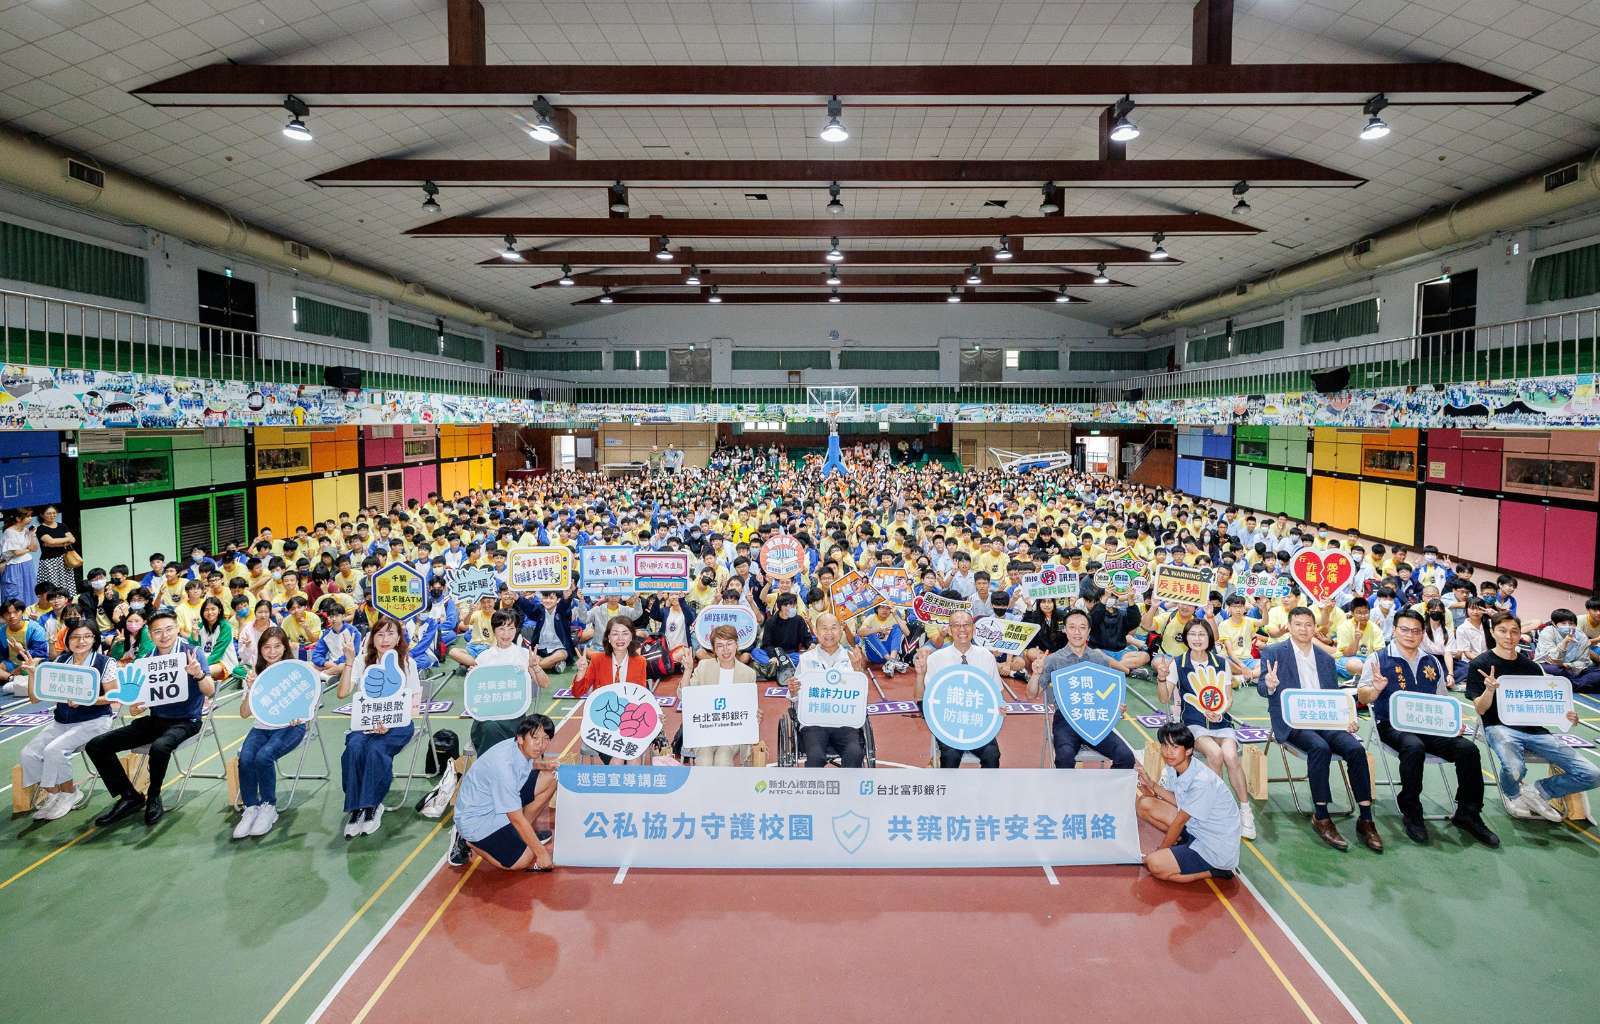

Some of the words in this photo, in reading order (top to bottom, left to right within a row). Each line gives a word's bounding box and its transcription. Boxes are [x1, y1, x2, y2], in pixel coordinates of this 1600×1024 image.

[1170, 570, 1201, 580] WARNING
[458, 579, 489, 593] 反詐騙
[1160, 579, 1200, 595] 反詐騙
[148, 658, 179, 673] 向詐騙
[148, 670, 179, 684] say
[1069, 675, 1094, 690] 多問
[149, 683, 180, 702] NO
[808, 687, 860, 700] 識詐力UP
[946, 686, 984, 709] 識詐
[1070, 691, 1096, 706] 多查
[1504, 689, 1565, 700] 防詐與你同行
[361, 700, 404, 714] 詐騙退散
[808, 702, 857, 714] 詐騙OUT
[1071, 707, 1110, 722] 多確定
[692, 710, 749, 723] 台北富邦銀行
[586, 727, 639, 757] 公私合擊
[576, 772, 667, 788] 巡迴宣導講座
[877, 783, 947, 796] 台北富邦銀行
[583, 811, 814, 841] 公私協力守護校園
[887, 814, 1117, 842] 共築防詐安全網絡
